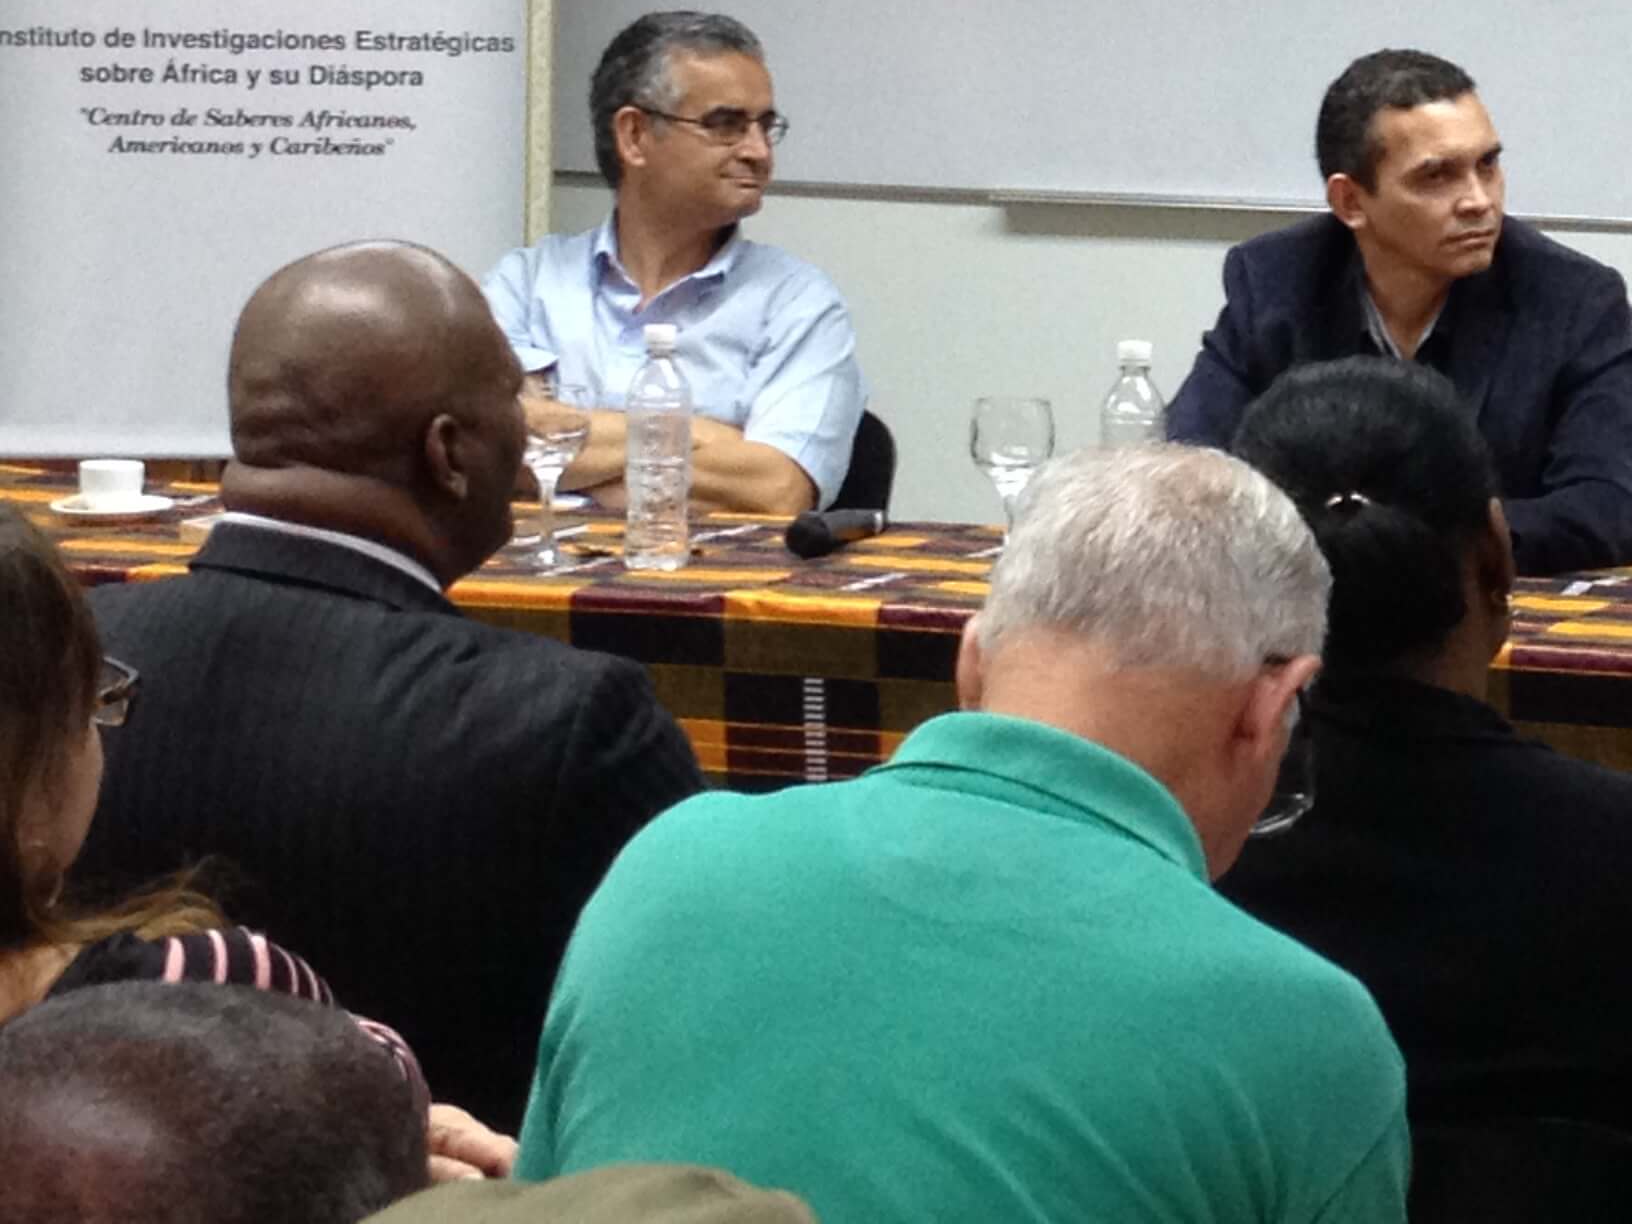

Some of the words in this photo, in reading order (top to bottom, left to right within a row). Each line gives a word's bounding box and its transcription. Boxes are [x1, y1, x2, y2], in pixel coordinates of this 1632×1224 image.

[103, 28, 136, 48] de
[143, 29, 346, 54] Investigaciones
[355, 30, 515, 57] Estratégicas
[80, 63, 154, 83] sobre
[162, 58, 238, 84] África
[246, 69, 262, 90] y
[269, 69, 299, 85] su
[308, 64, 424, 91] Diáspora
[170, 108, 198, 127] de
[203, 108, 293, 128] Saberes
[108, 136, 244, 154] Americanos
[247, 141, 263, 158] y
